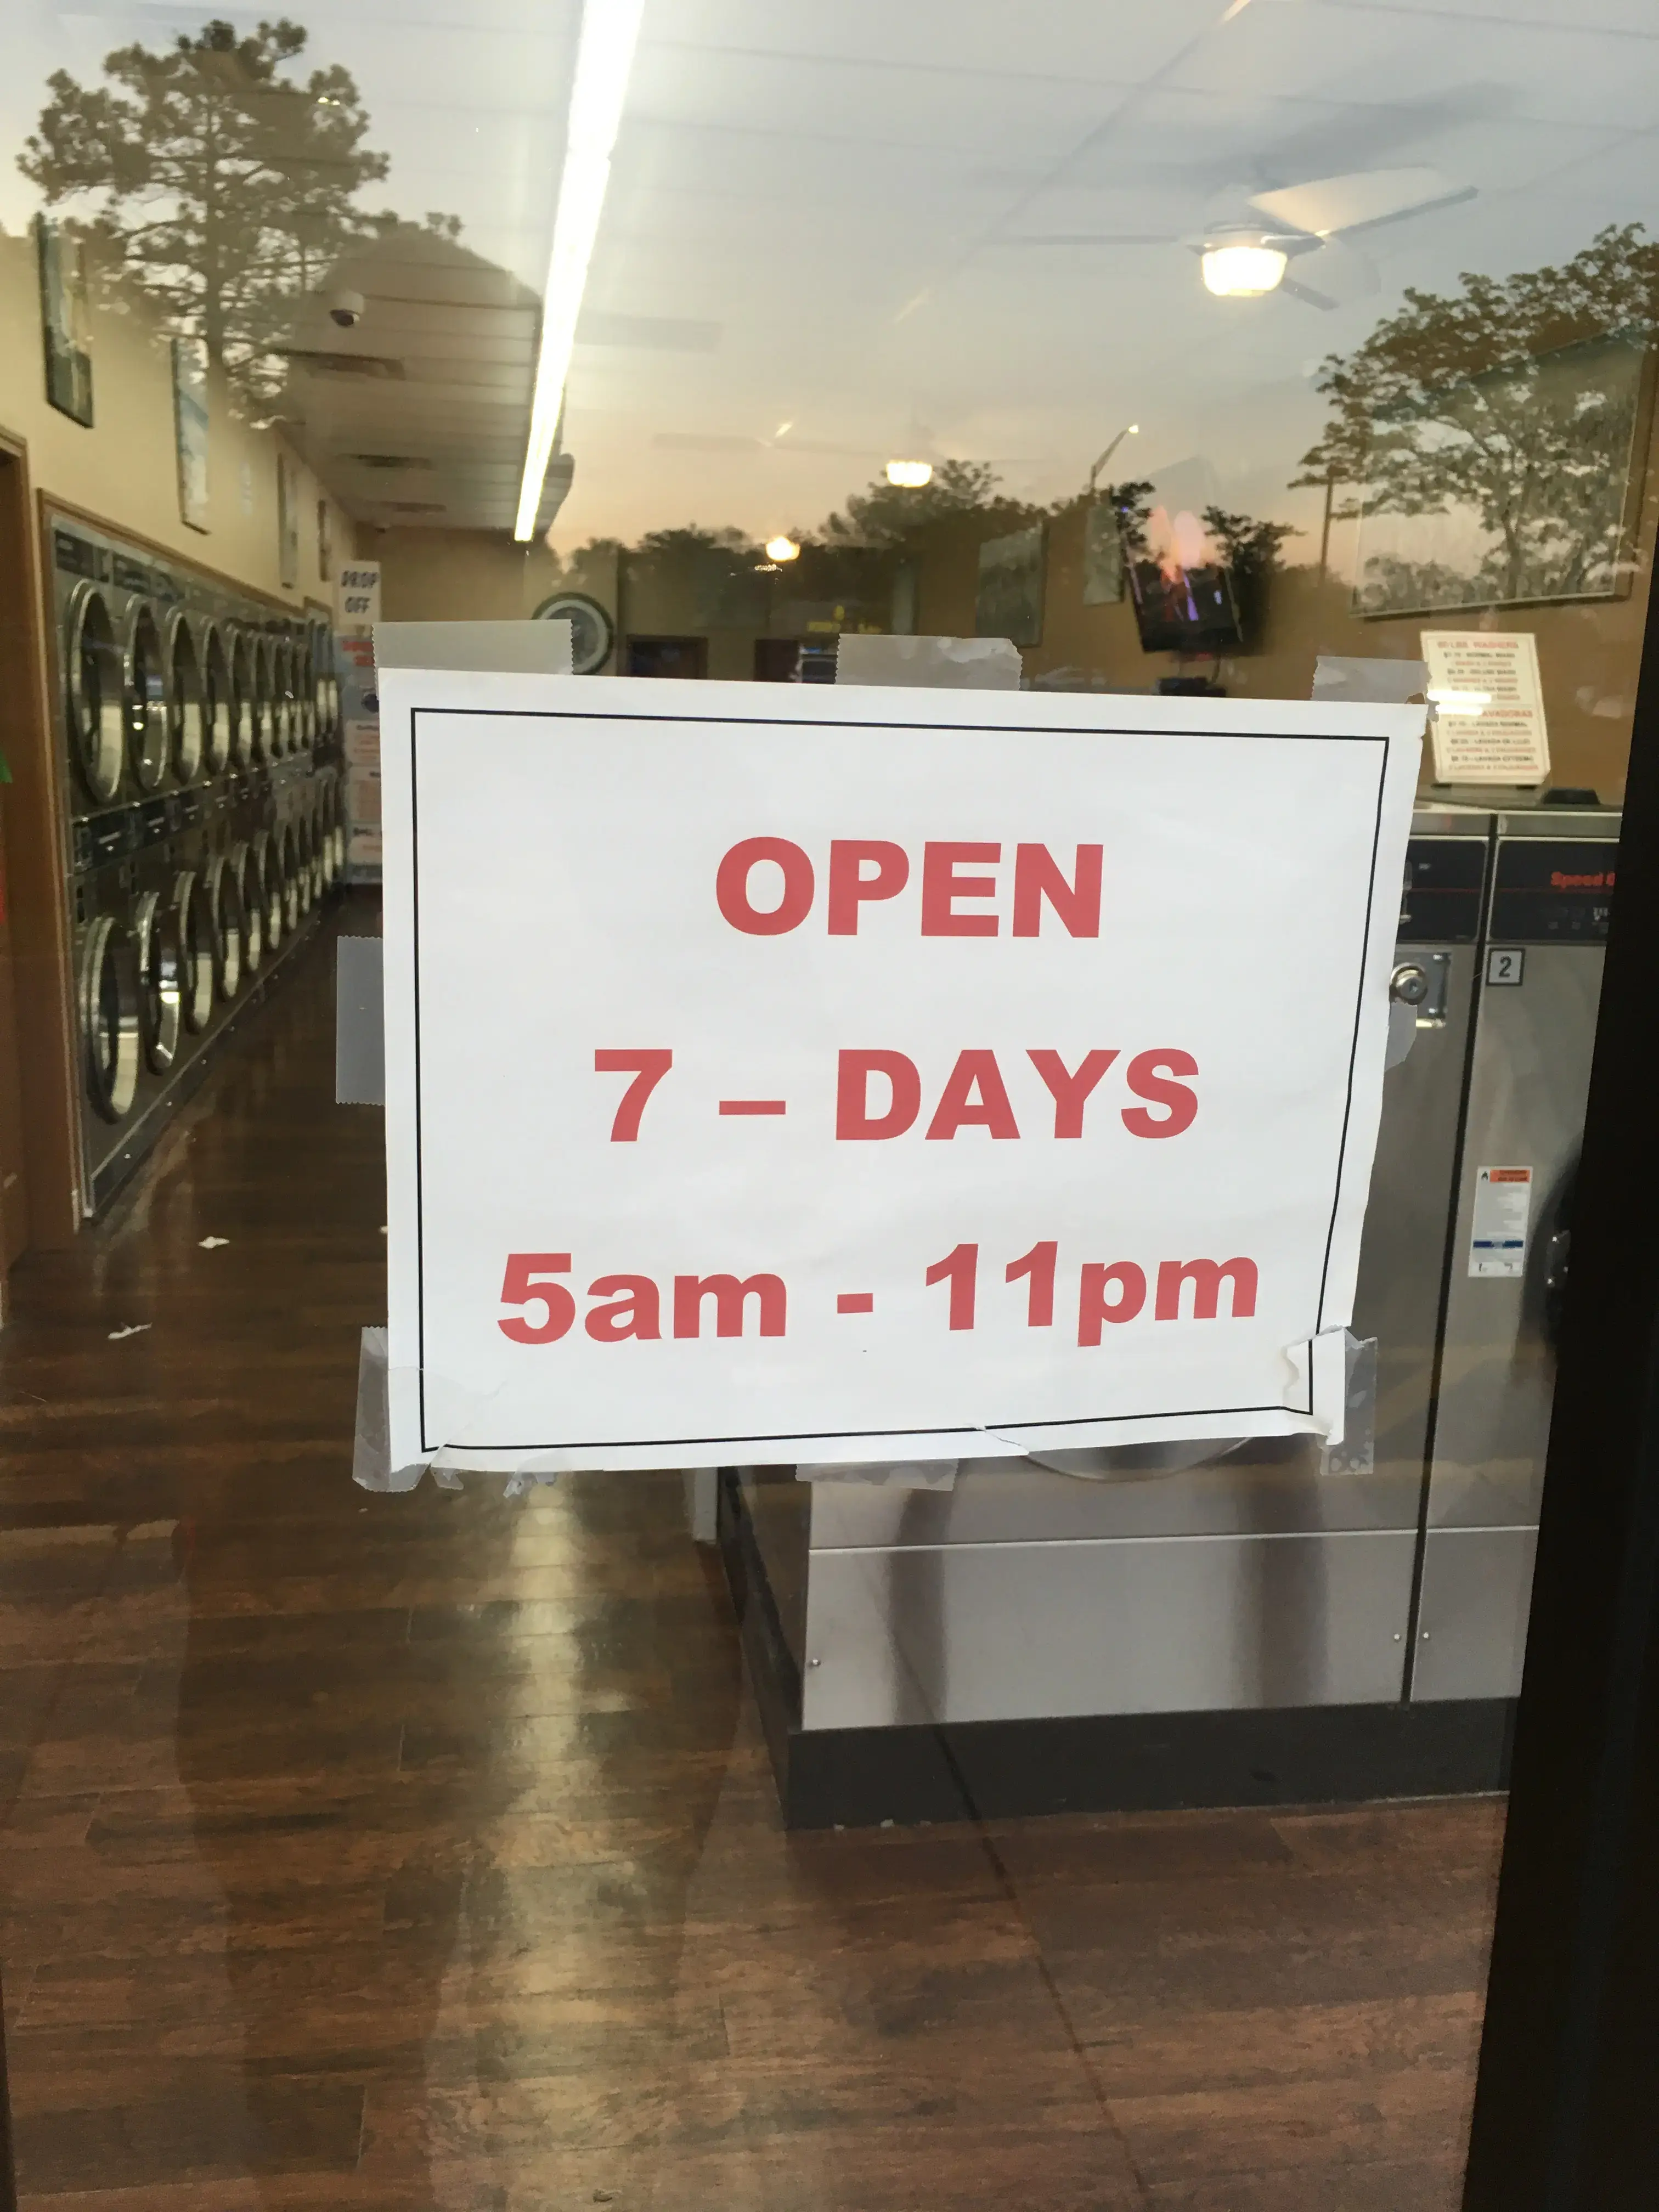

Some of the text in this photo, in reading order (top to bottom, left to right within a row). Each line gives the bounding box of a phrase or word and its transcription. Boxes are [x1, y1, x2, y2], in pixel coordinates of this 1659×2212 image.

[341, 570, 379, 588] DROP
[345, 596, 371, 614] OFF
[716, 837, 1104, 938] OPEN
[1550, 871, 1604, 889] Speed
[1498, 956, 1513, 978] 2
[594, 1049, 673, 1142] 7
[836, 1049, 1199, 1141] DAYS
[498, 1253, 787, 1345] 5am
[925, 1241, 1259, 1347] 11pm
